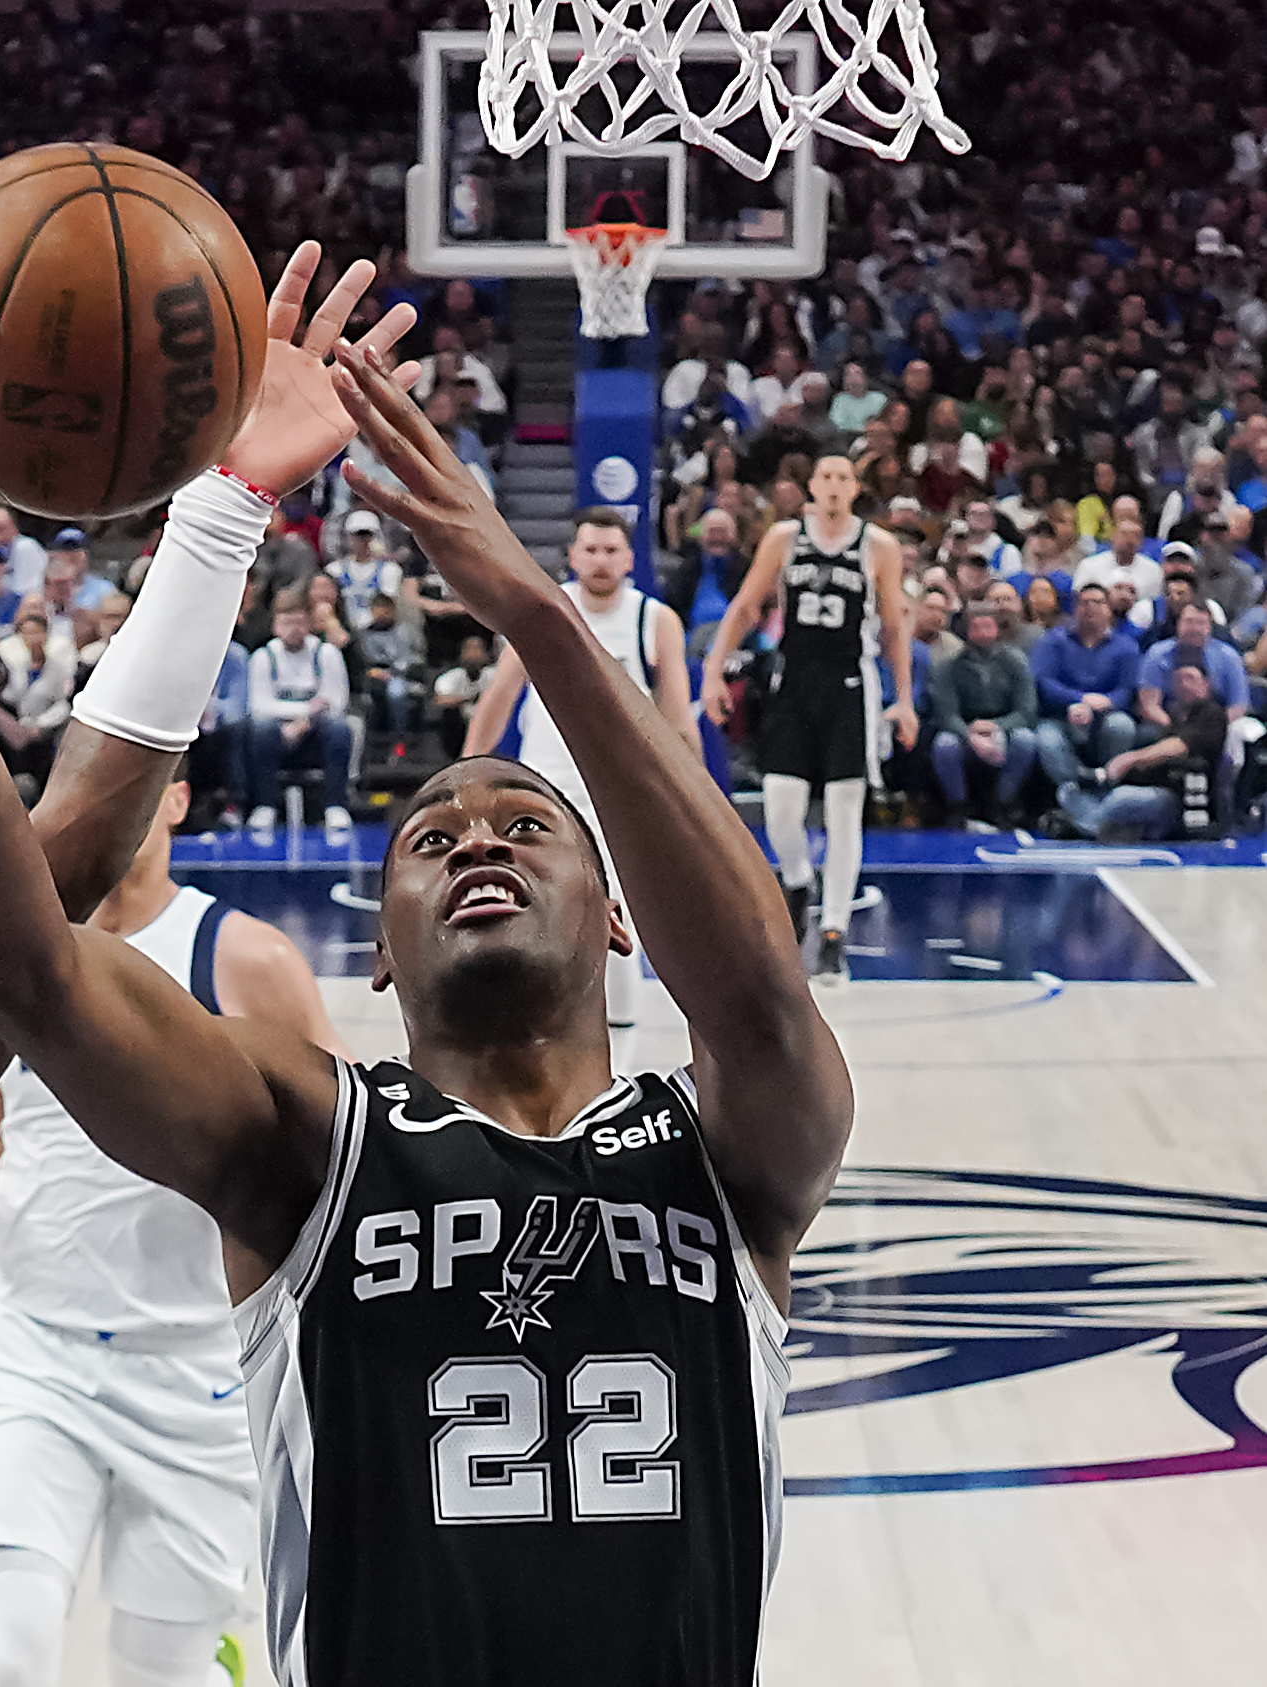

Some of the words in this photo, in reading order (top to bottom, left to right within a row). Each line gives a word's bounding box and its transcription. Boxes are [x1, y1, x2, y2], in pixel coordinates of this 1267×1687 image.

[592, 1109, 682, 1156] Self.
[352, 1195, 718, 1343] SPURS
[427, 1353, 682, 1526] 22
